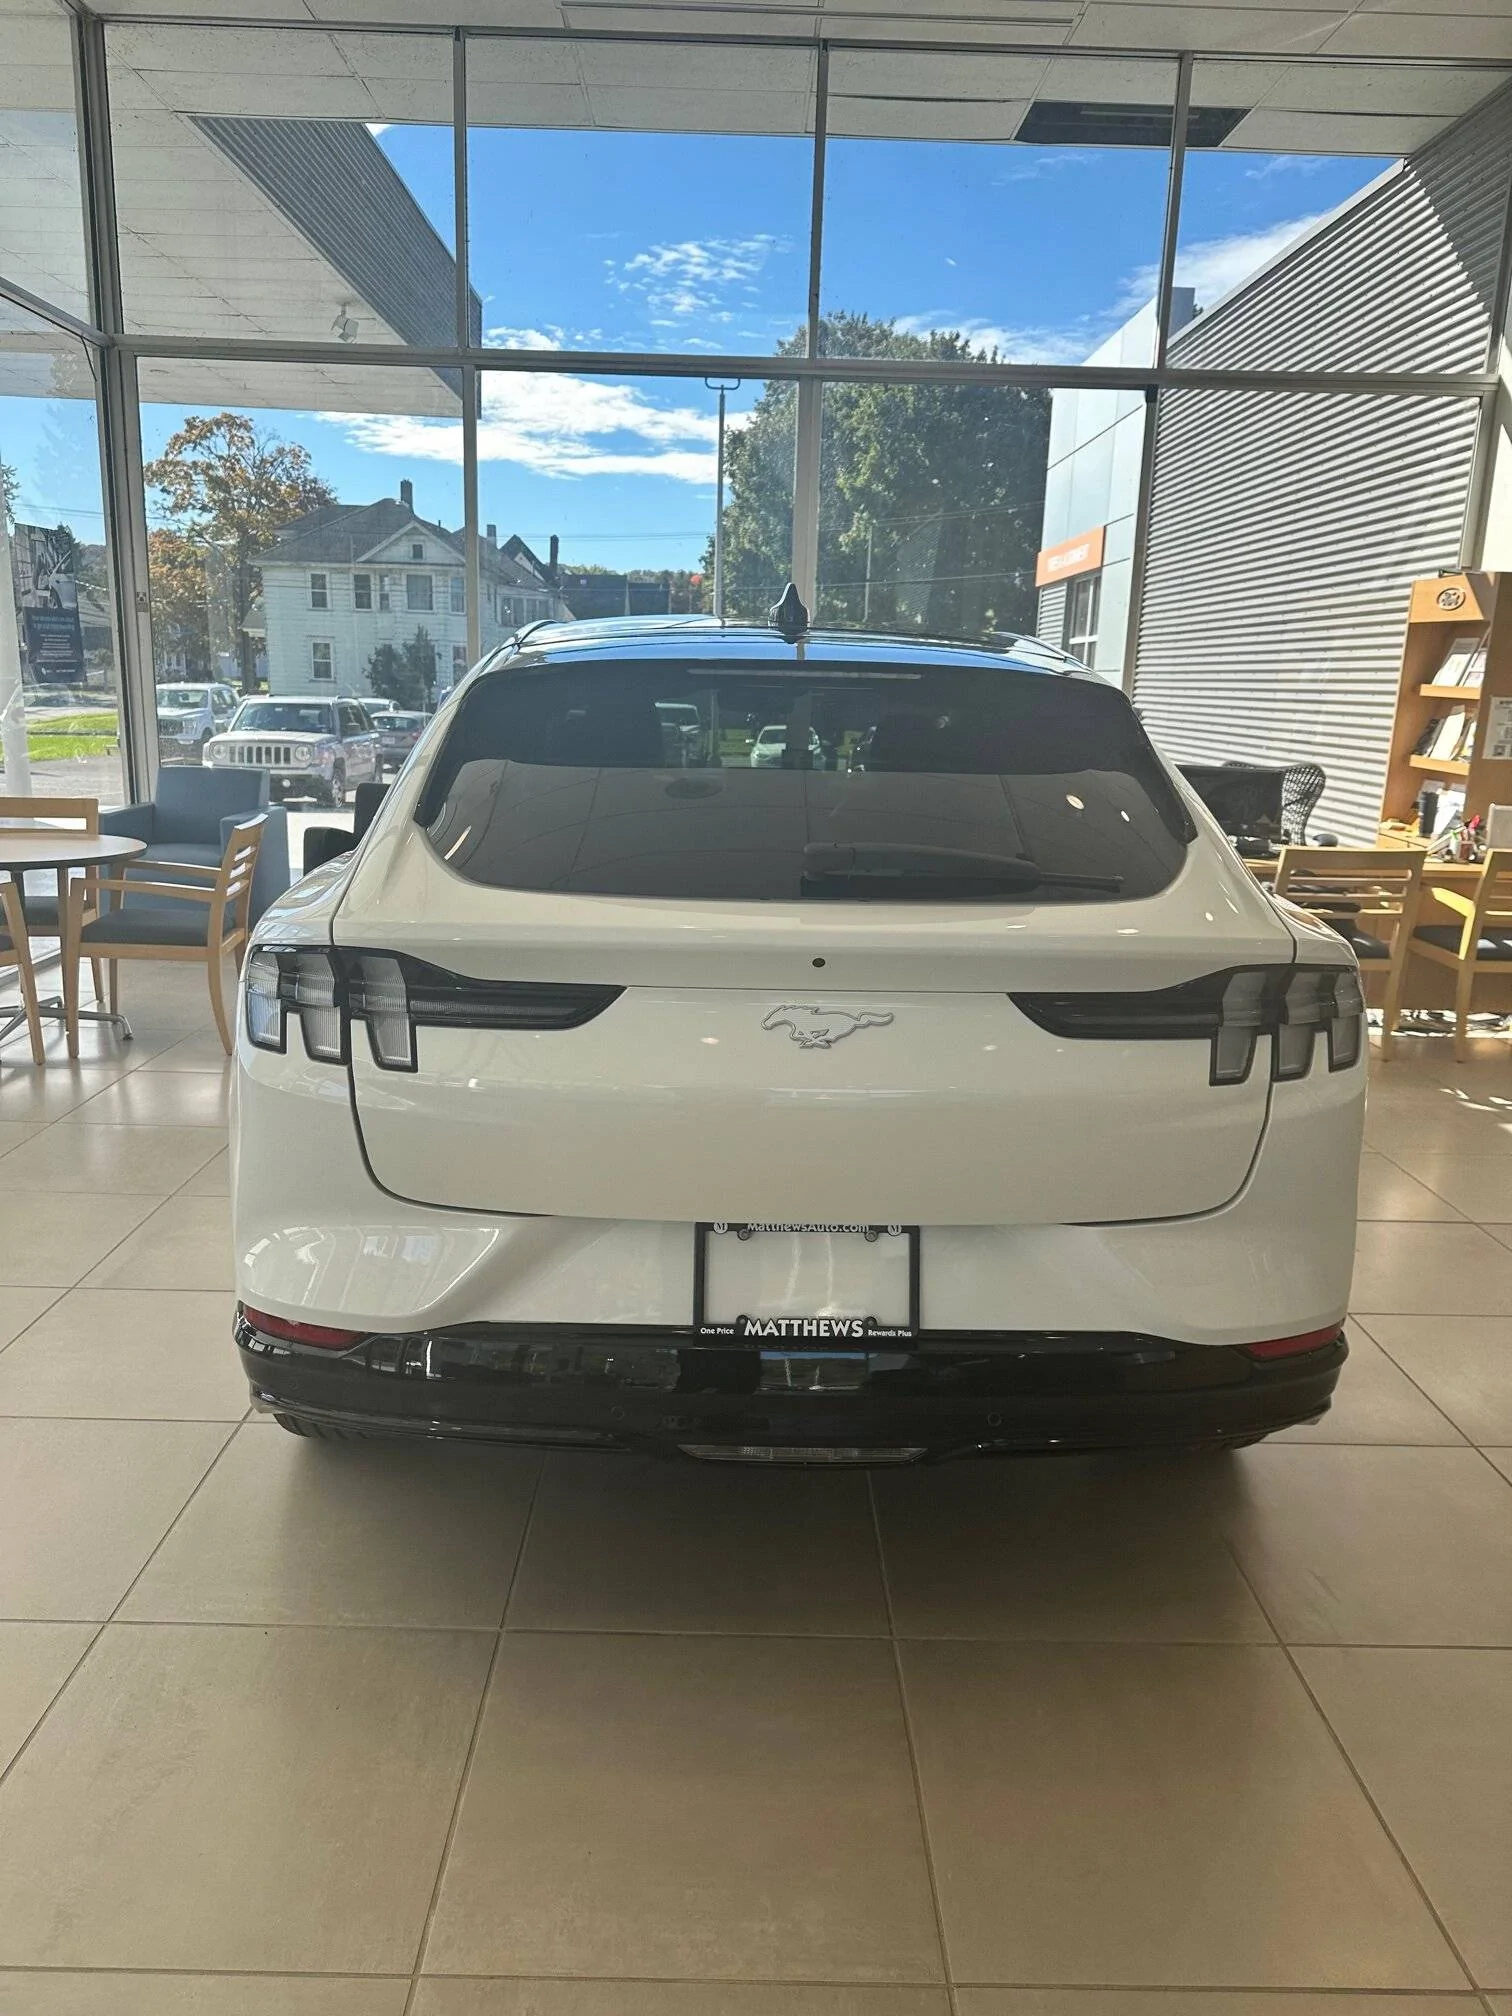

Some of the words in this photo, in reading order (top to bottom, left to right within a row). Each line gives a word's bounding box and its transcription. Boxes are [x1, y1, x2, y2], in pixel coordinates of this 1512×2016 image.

[700, 1327, 715, 1335] One
[716, 1327, 735, 1335] Price
[743, 1319, 864, 1337] MATTHEWS
[867, 1329, 897, 1337] Rewards
[897, 1329, 912, 1337] Plus
